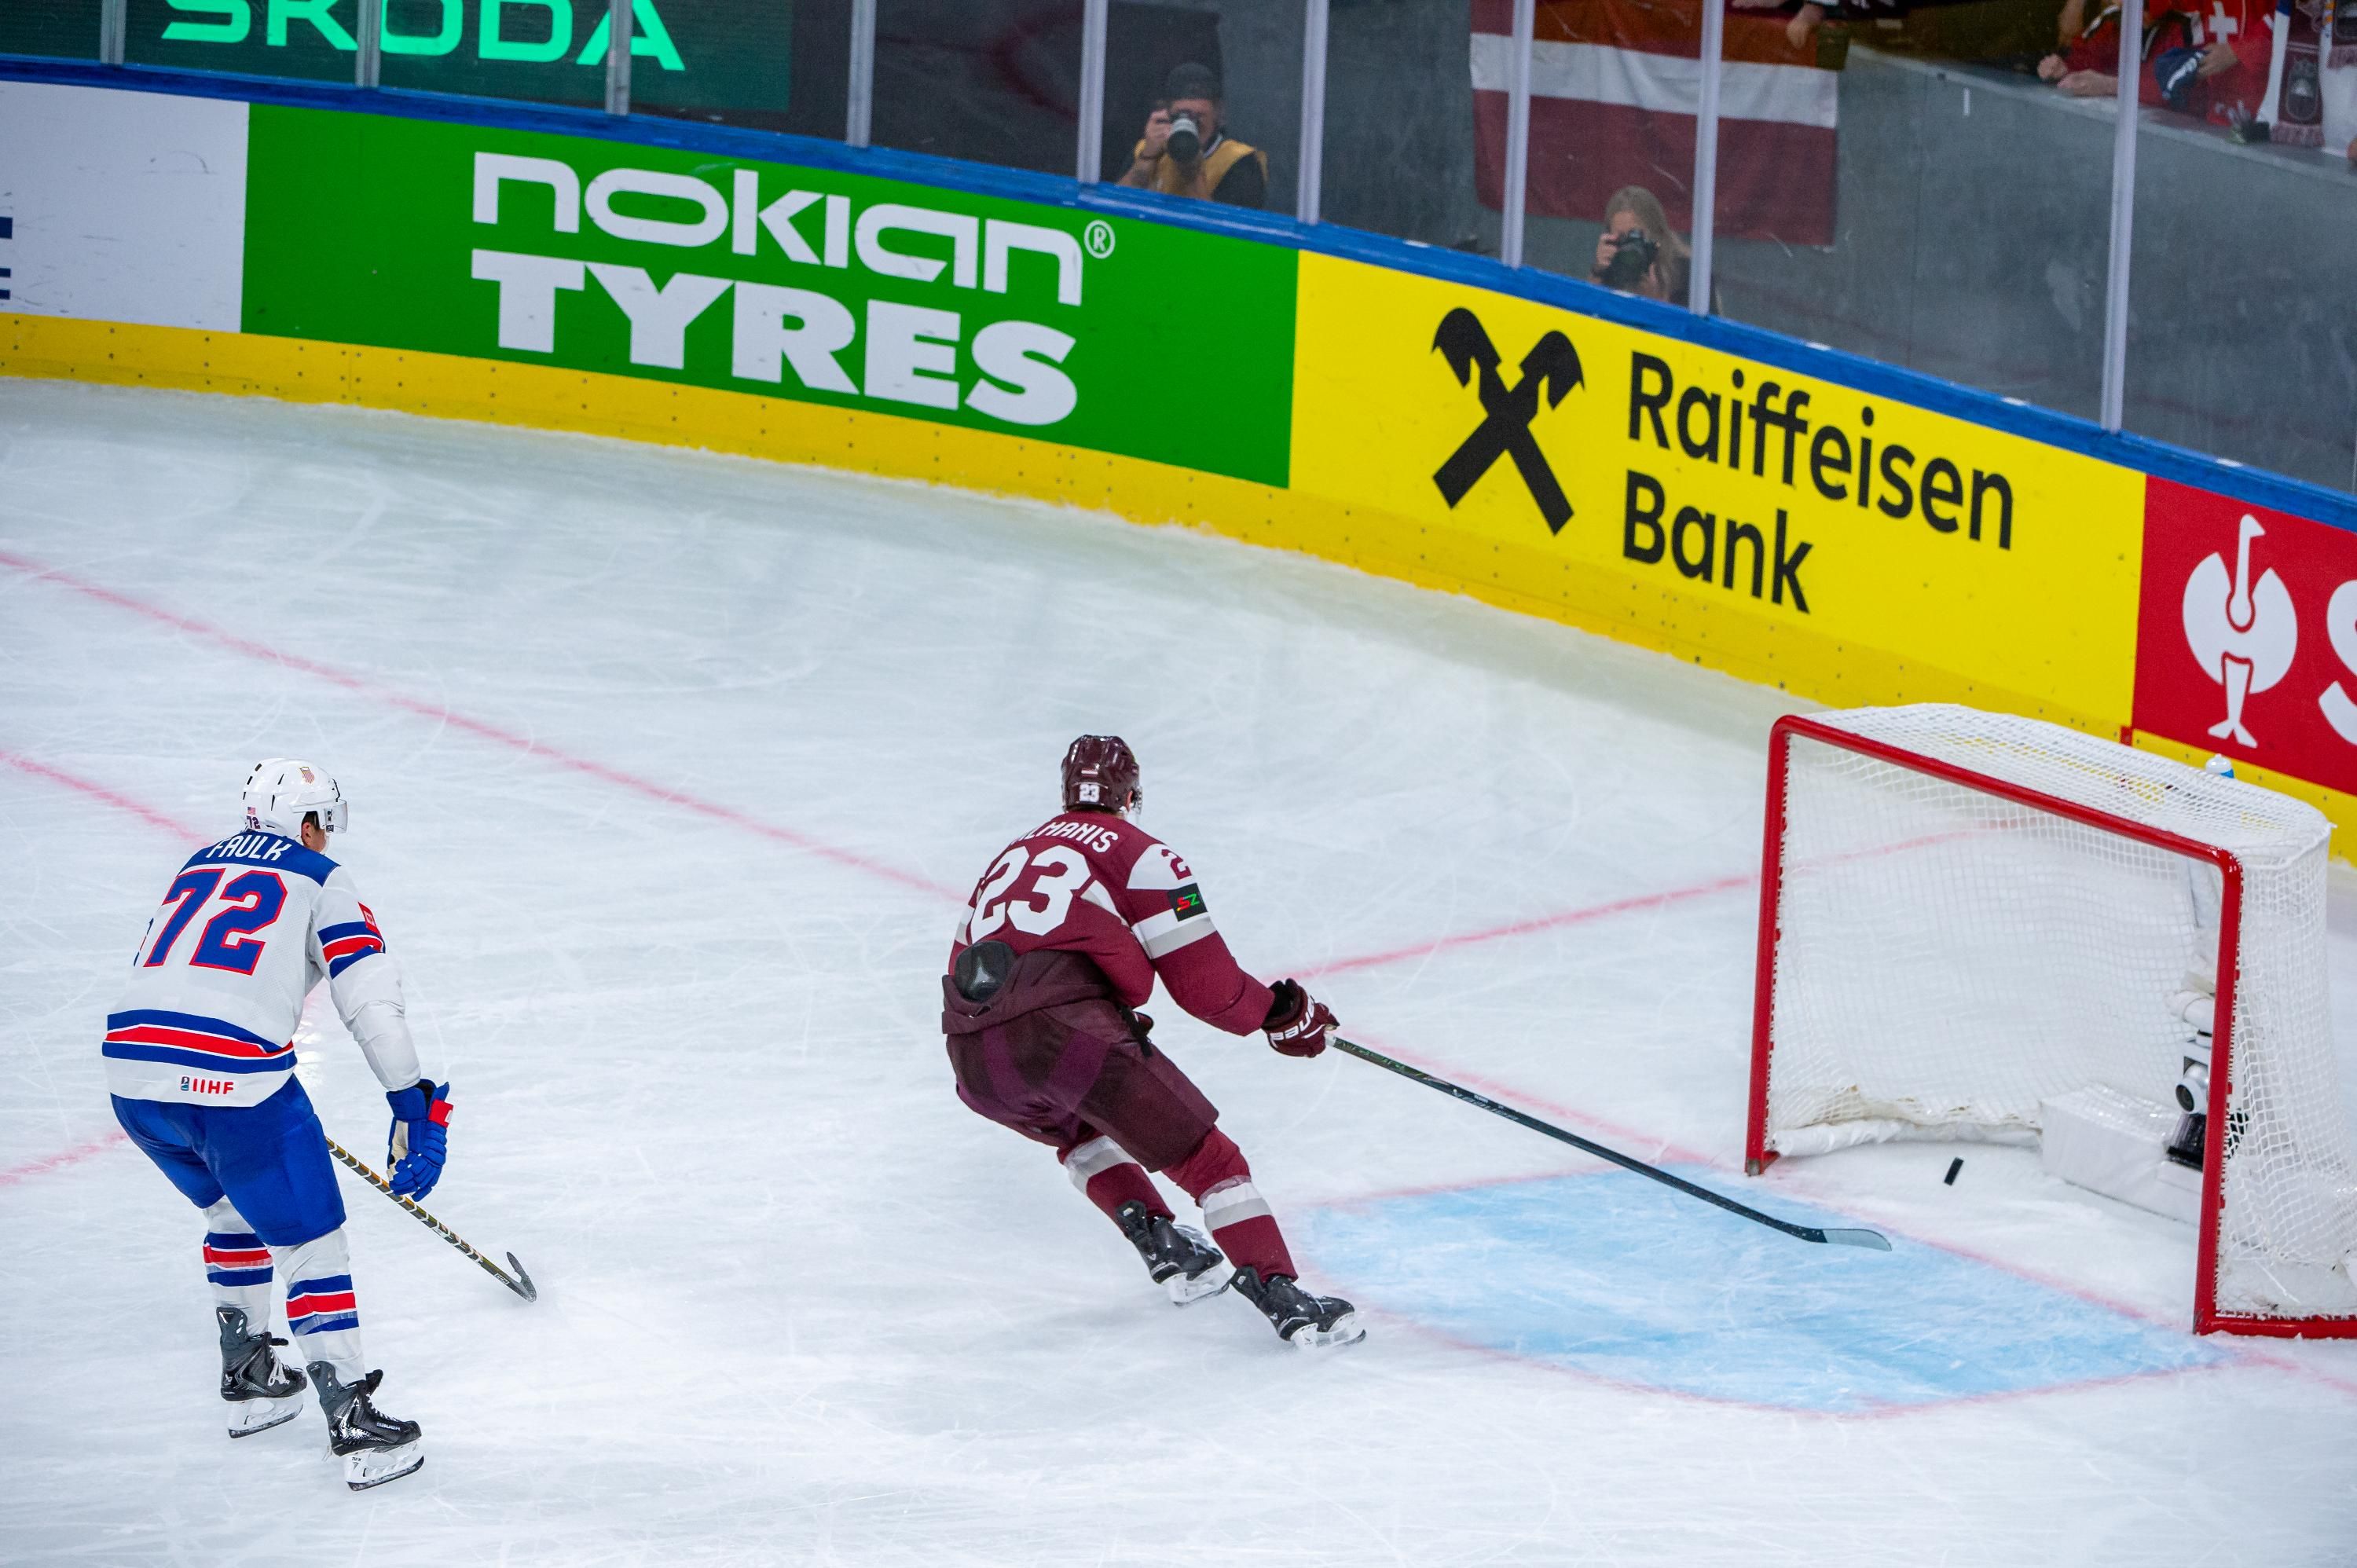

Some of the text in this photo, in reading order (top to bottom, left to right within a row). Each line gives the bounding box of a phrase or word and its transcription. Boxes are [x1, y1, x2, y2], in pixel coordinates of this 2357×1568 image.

[472, 152, 1083, 306] nokian
[471, 248, 1078, 427] TYRES
[1628, 350, 2014, 551] Raiffeisen
[1622, 469, 1814, 614] Bank
[246, 815, 261, 830] 72
[1080, 784, 1100, 802] 23
[205, 833, 292, 861] FAULK
[970, 844, 1092, 943] 23
[143, 867, 288, 976] 72
[192, 1078, 234, 1095] IIHF
[376, 1422, 401, 1431] BAUER
